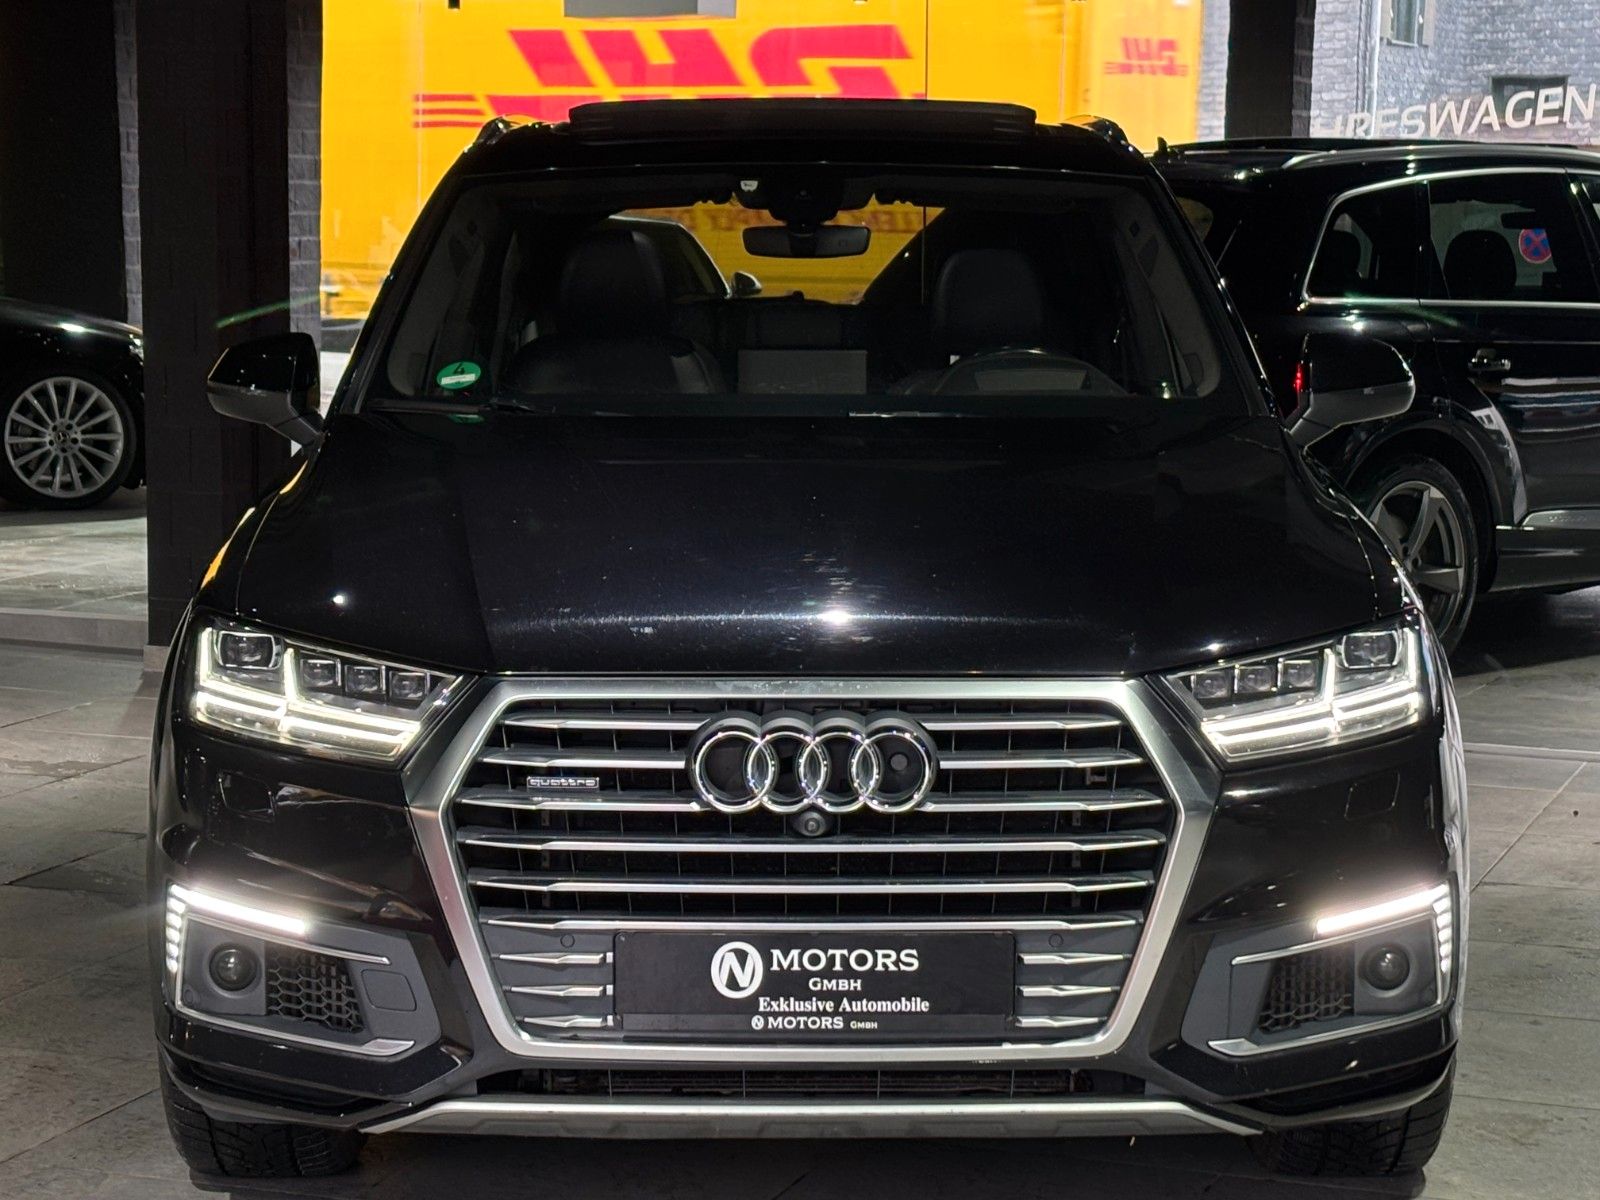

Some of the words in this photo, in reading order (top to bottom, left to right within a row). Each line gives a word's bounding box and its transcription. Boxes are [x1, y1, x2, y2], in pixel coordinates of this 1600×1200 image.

[530, 779, 595, 787] quattro
[770, 948, 919, 972] MOTORS
[808, 977, 862, 991] GMBH
[758, 997, 834, 1012] Exklusive
[839, 997, 930, 1012] Automobile
[768, 1016, 844, 1029] MOTORS
[850, 1020, 878, 1029] GMBH
